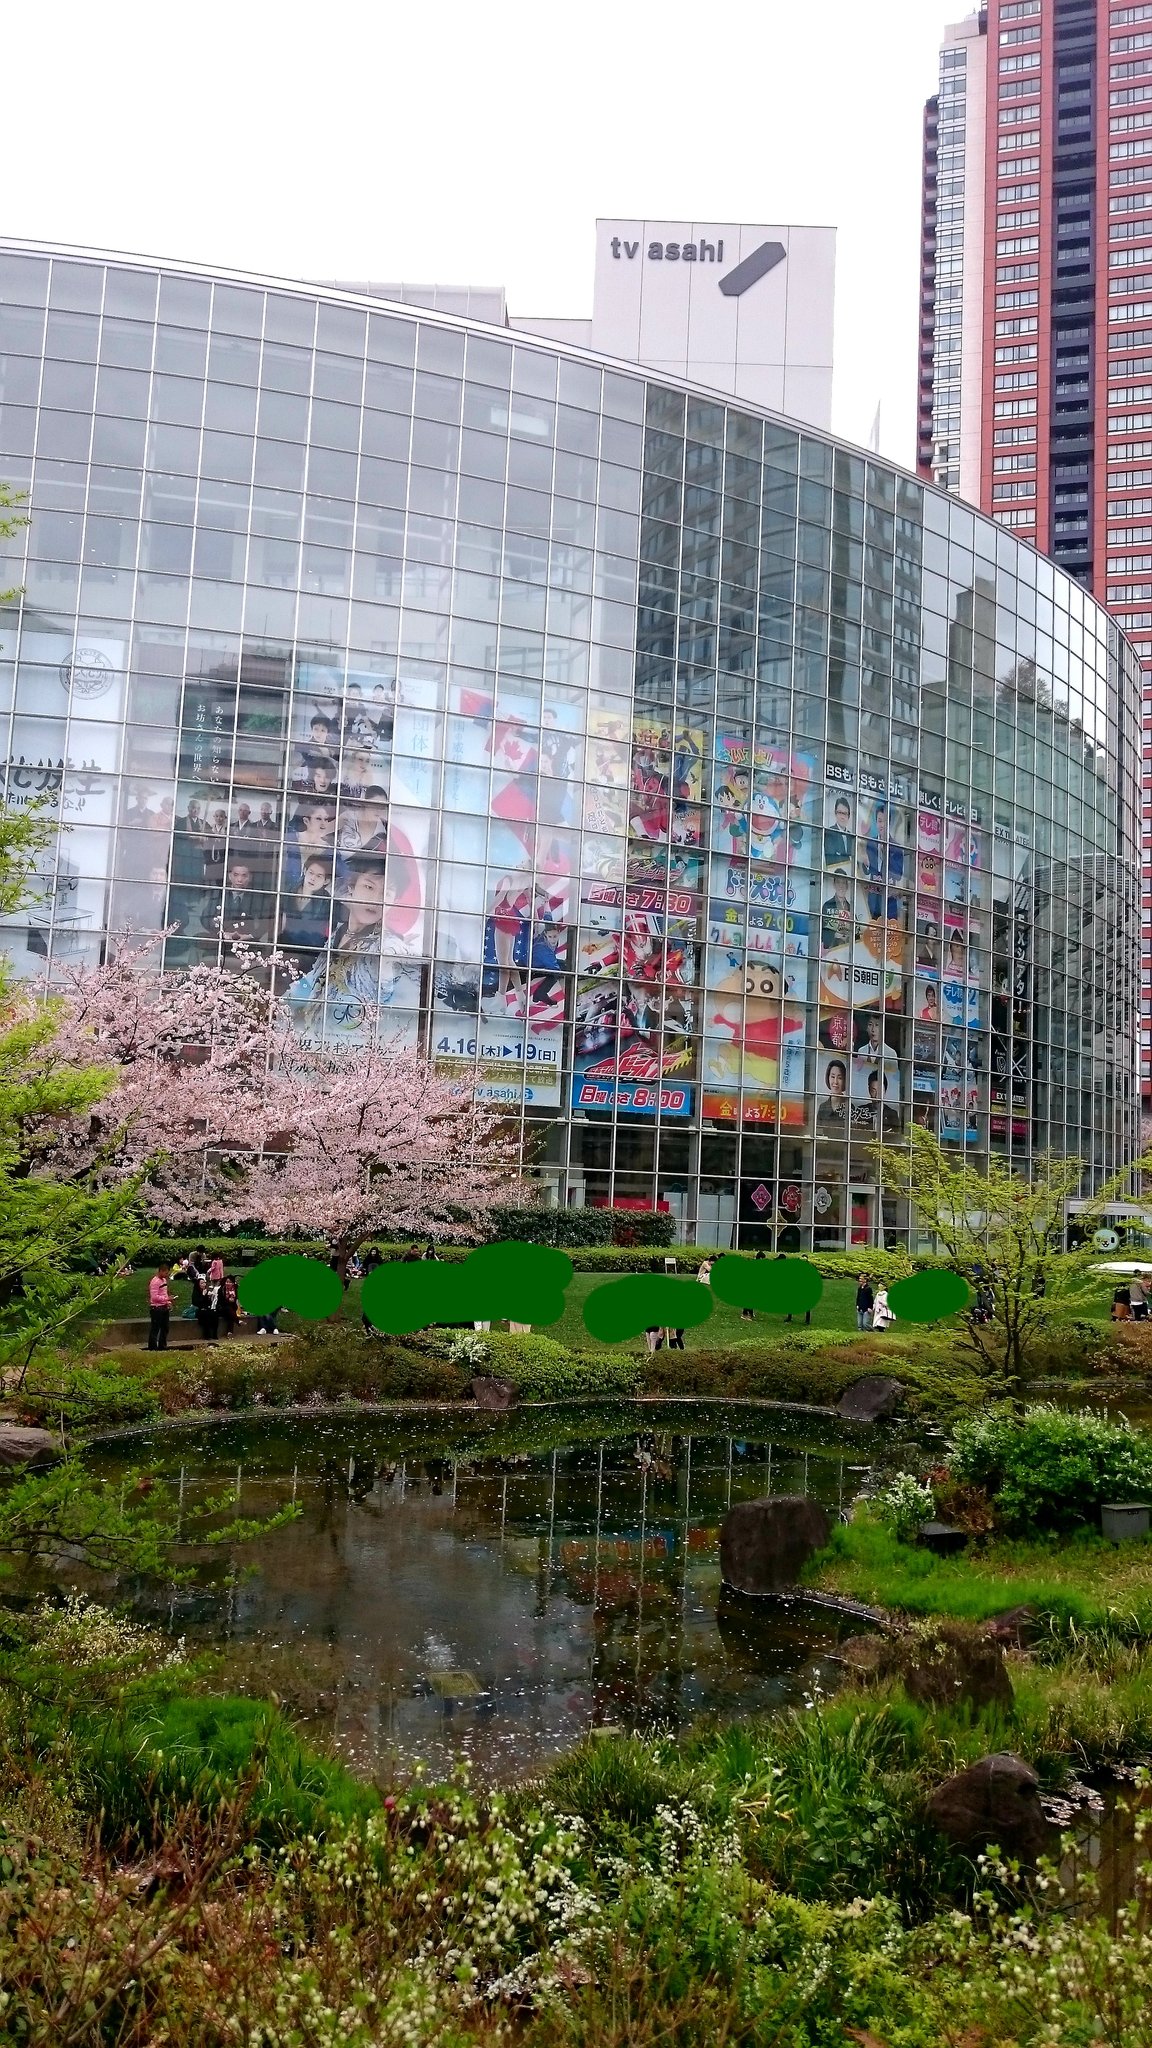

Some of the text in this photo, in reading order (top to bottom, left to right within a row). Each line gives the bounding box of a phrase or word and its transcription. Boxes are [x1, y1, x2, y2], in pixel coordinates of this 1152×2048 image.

[611, 237, 724, 262] tv asahi
[632, 1088, 685, 1110] 8:00
